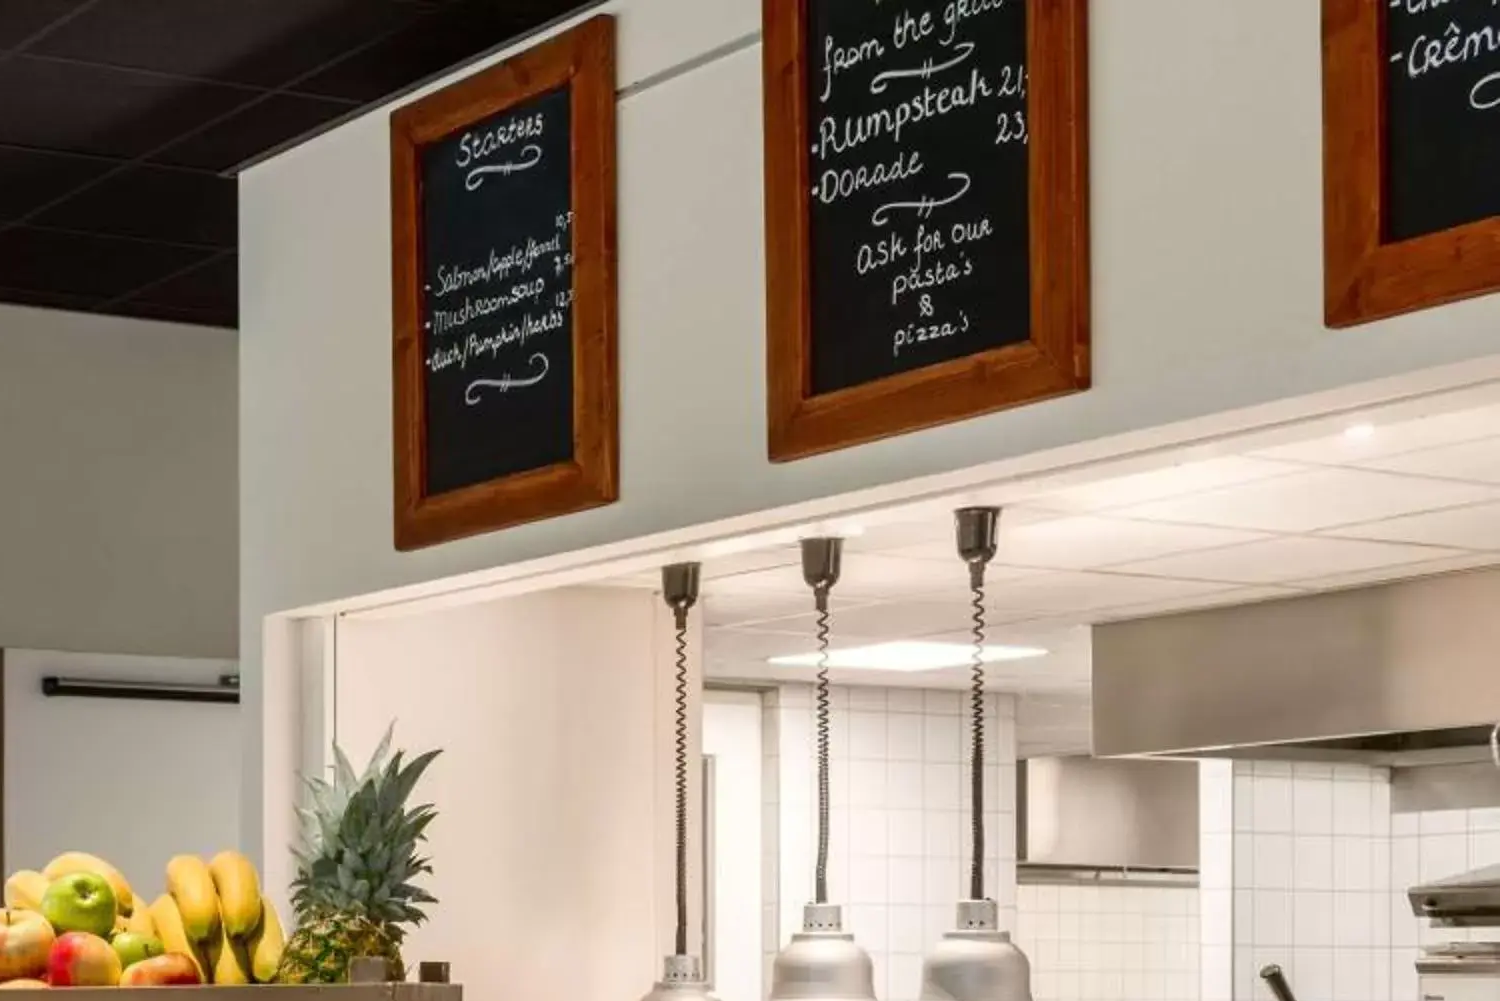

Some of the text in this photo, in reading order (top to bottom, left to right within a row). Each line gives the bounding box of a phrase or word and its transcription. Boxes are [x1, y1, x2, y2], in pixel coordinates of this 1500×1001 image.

[893, 9, 934, 49] the
[1407, 21, 1500, 79] Crêm
[819, 68, 993, 160] Rumpsteak
